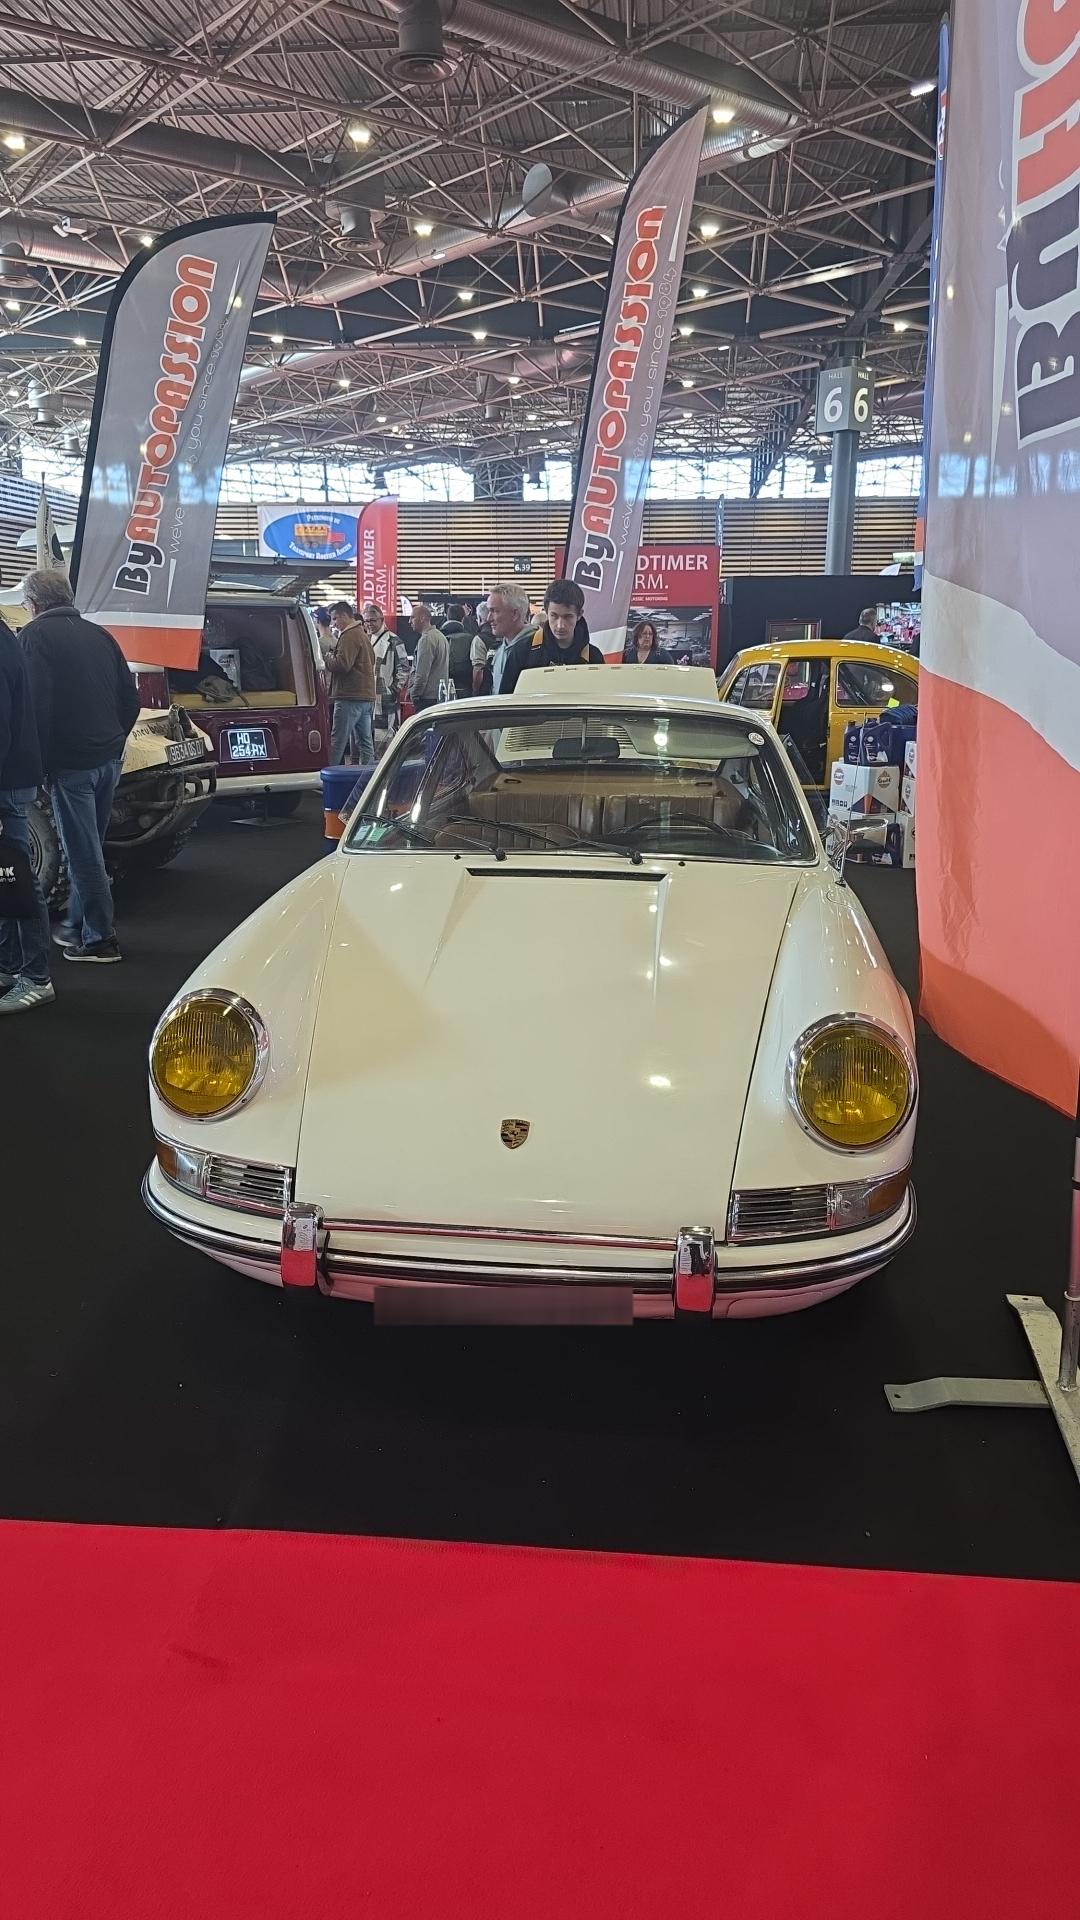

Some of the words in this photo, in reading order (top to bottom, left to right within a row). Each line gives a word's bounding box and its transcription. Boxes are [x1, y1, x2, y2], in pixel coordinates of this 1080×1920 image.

[640, 386, 654, 426] you
[649, 325, 664, 380] since
[188, 414, 202, 450] you
[200, 363, 215, 410] since
[824, 387, 842, 422] 6
[854, 388, 868, 422] 6
[514, 564, 530, 572] 6.39
[637, 555, 708, 570] DTIMER
[635, 574, 668, 589] RM.
